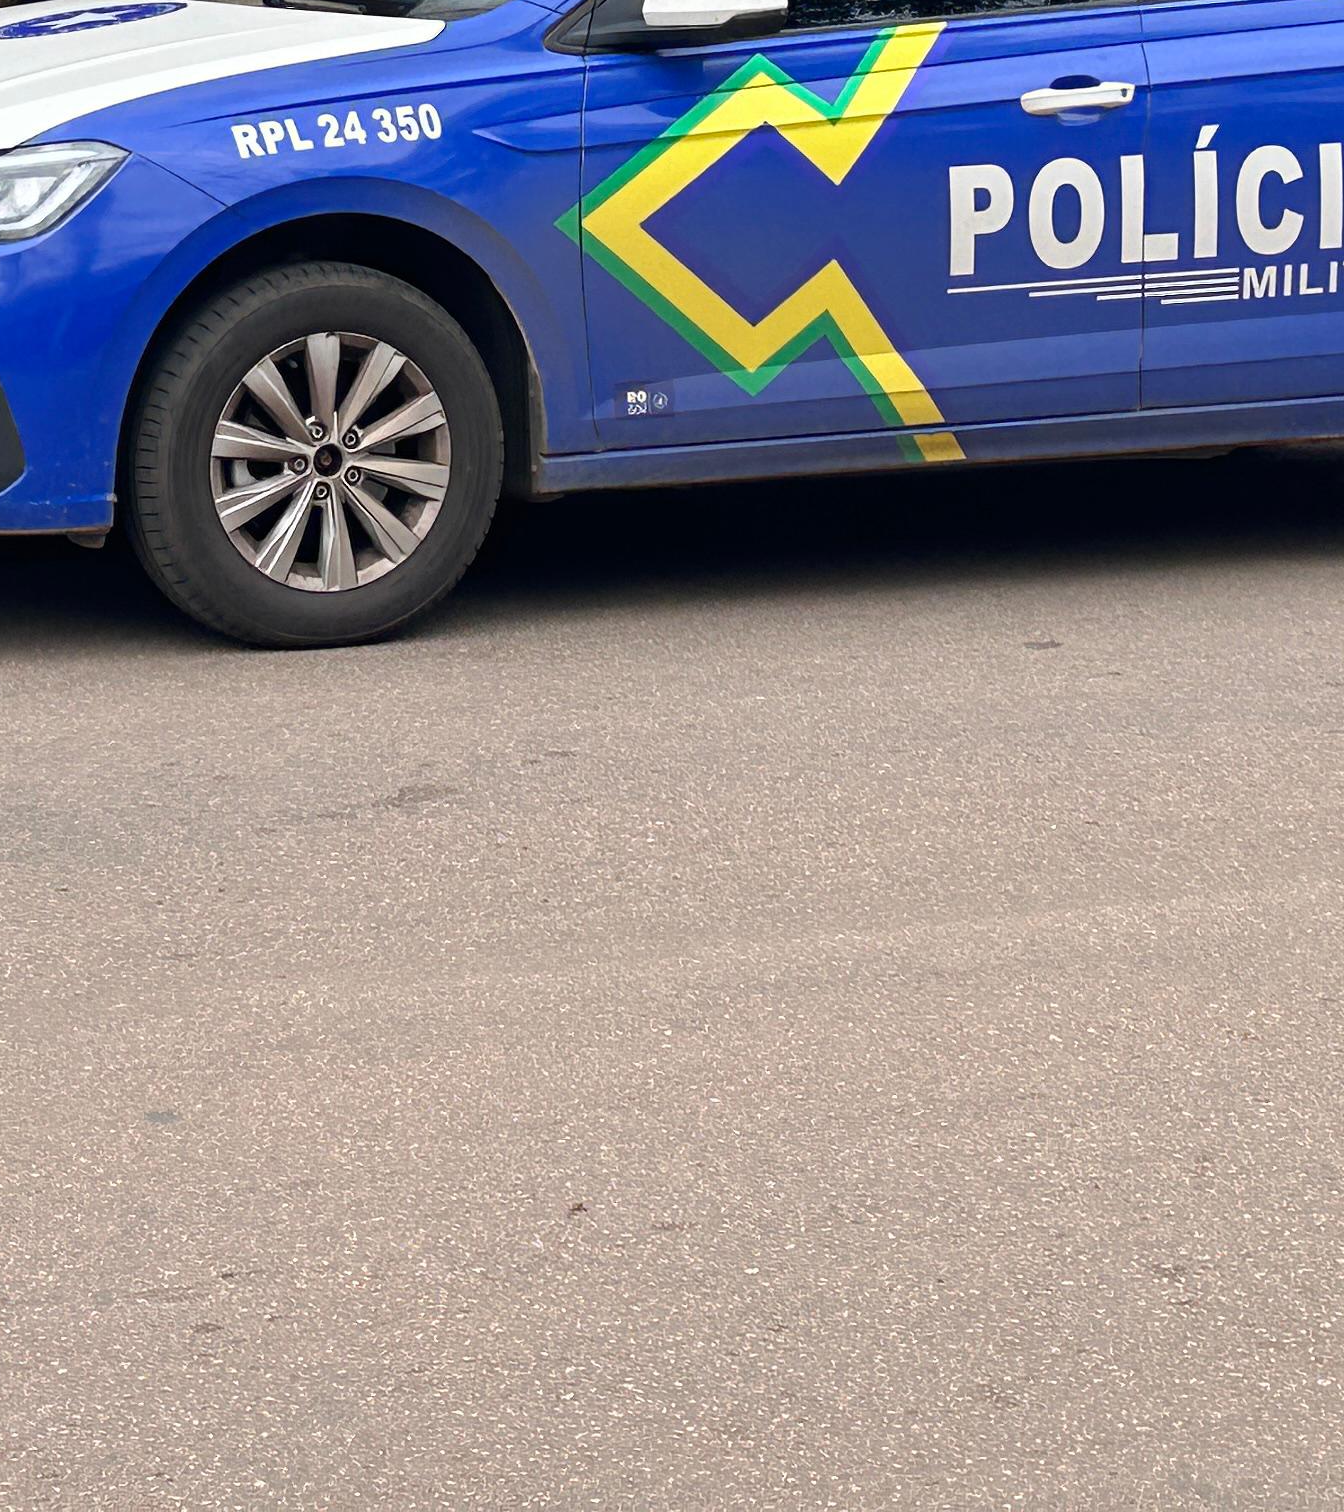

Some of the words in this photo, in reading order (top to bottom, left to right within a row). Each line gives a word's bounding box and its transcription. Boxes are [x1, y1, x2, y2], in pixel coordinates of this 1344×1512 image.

[230, 118, 315, 159] RPL
[316, 110, 367, 148] 24
[371, 103, 443, 144] 350
